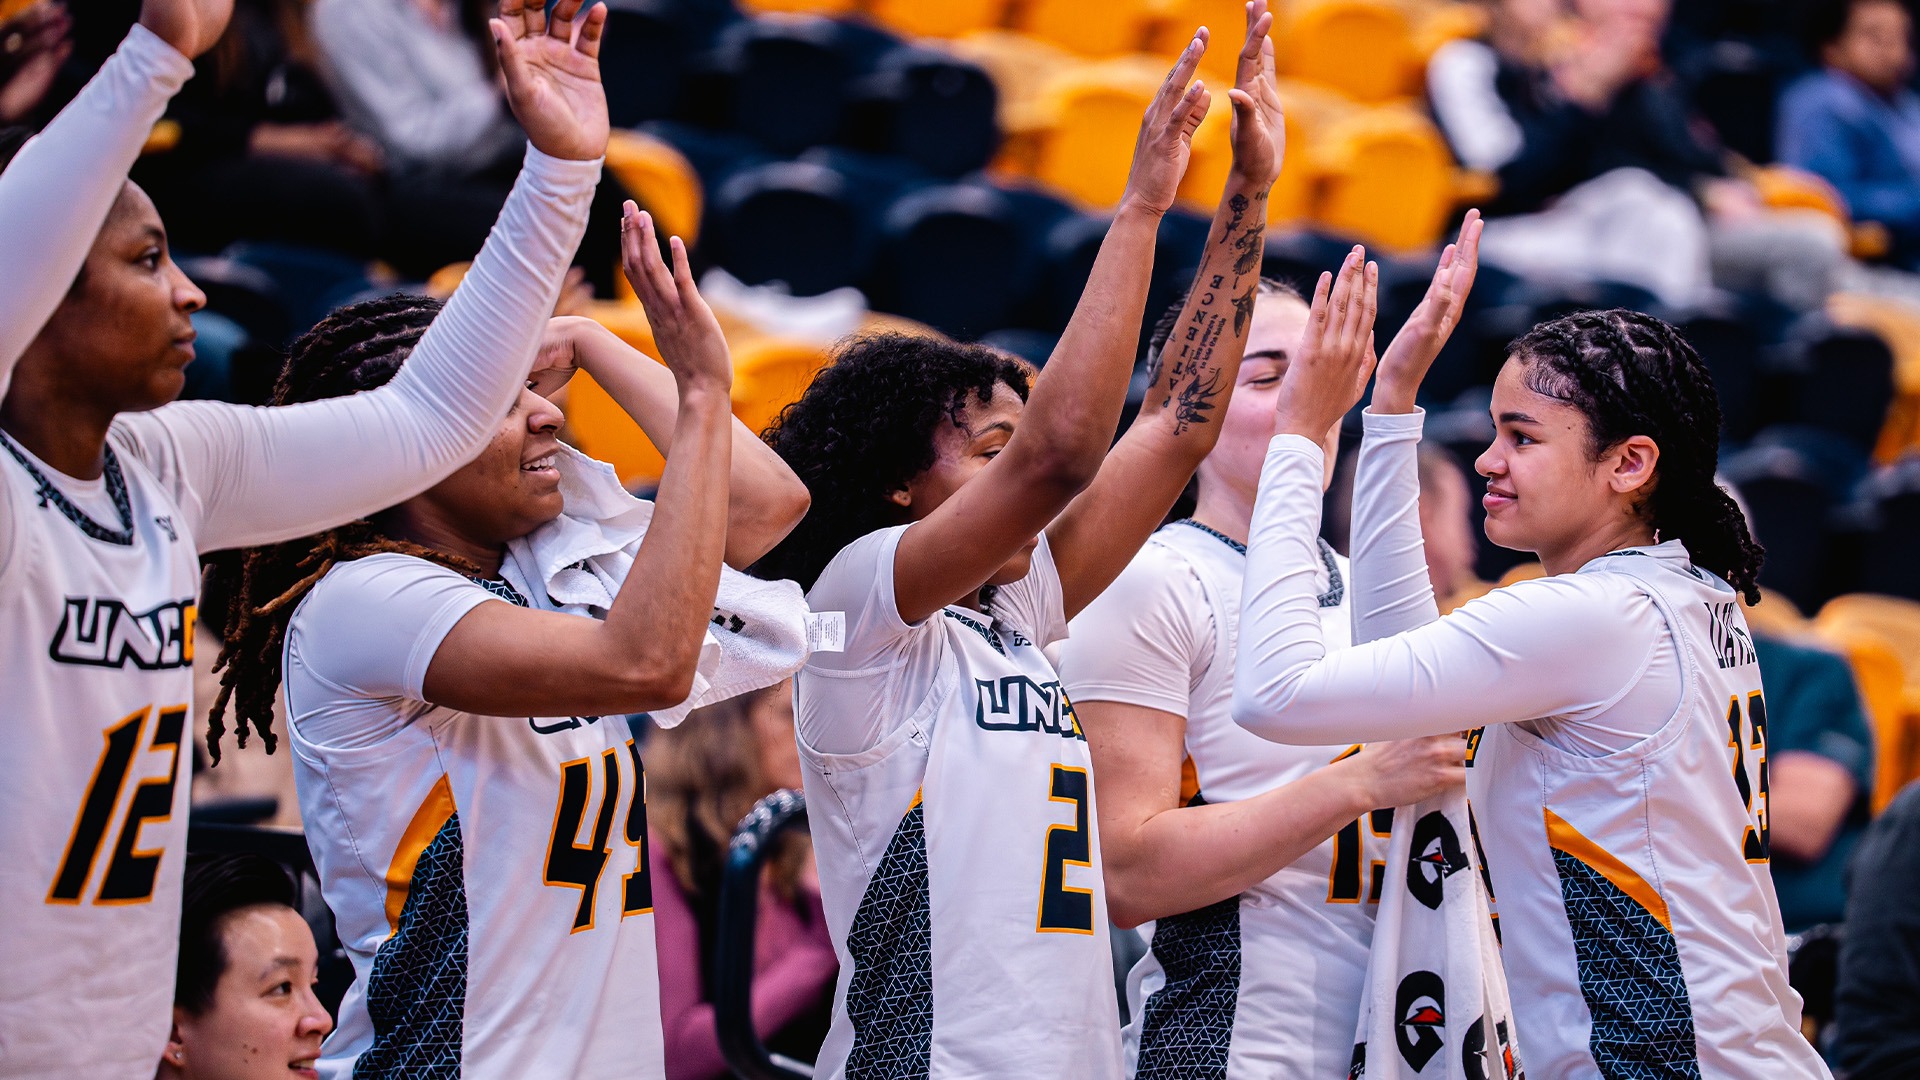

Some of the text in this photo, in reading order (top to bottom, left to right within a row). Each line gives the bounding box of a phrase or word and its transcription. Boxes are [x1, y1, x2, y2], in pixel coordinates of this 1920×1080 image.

[1162, 274, 1224, 408] PATIENCE
[45, 704, 188, 906] 12
[1036, 763, 1095, 935] 2
